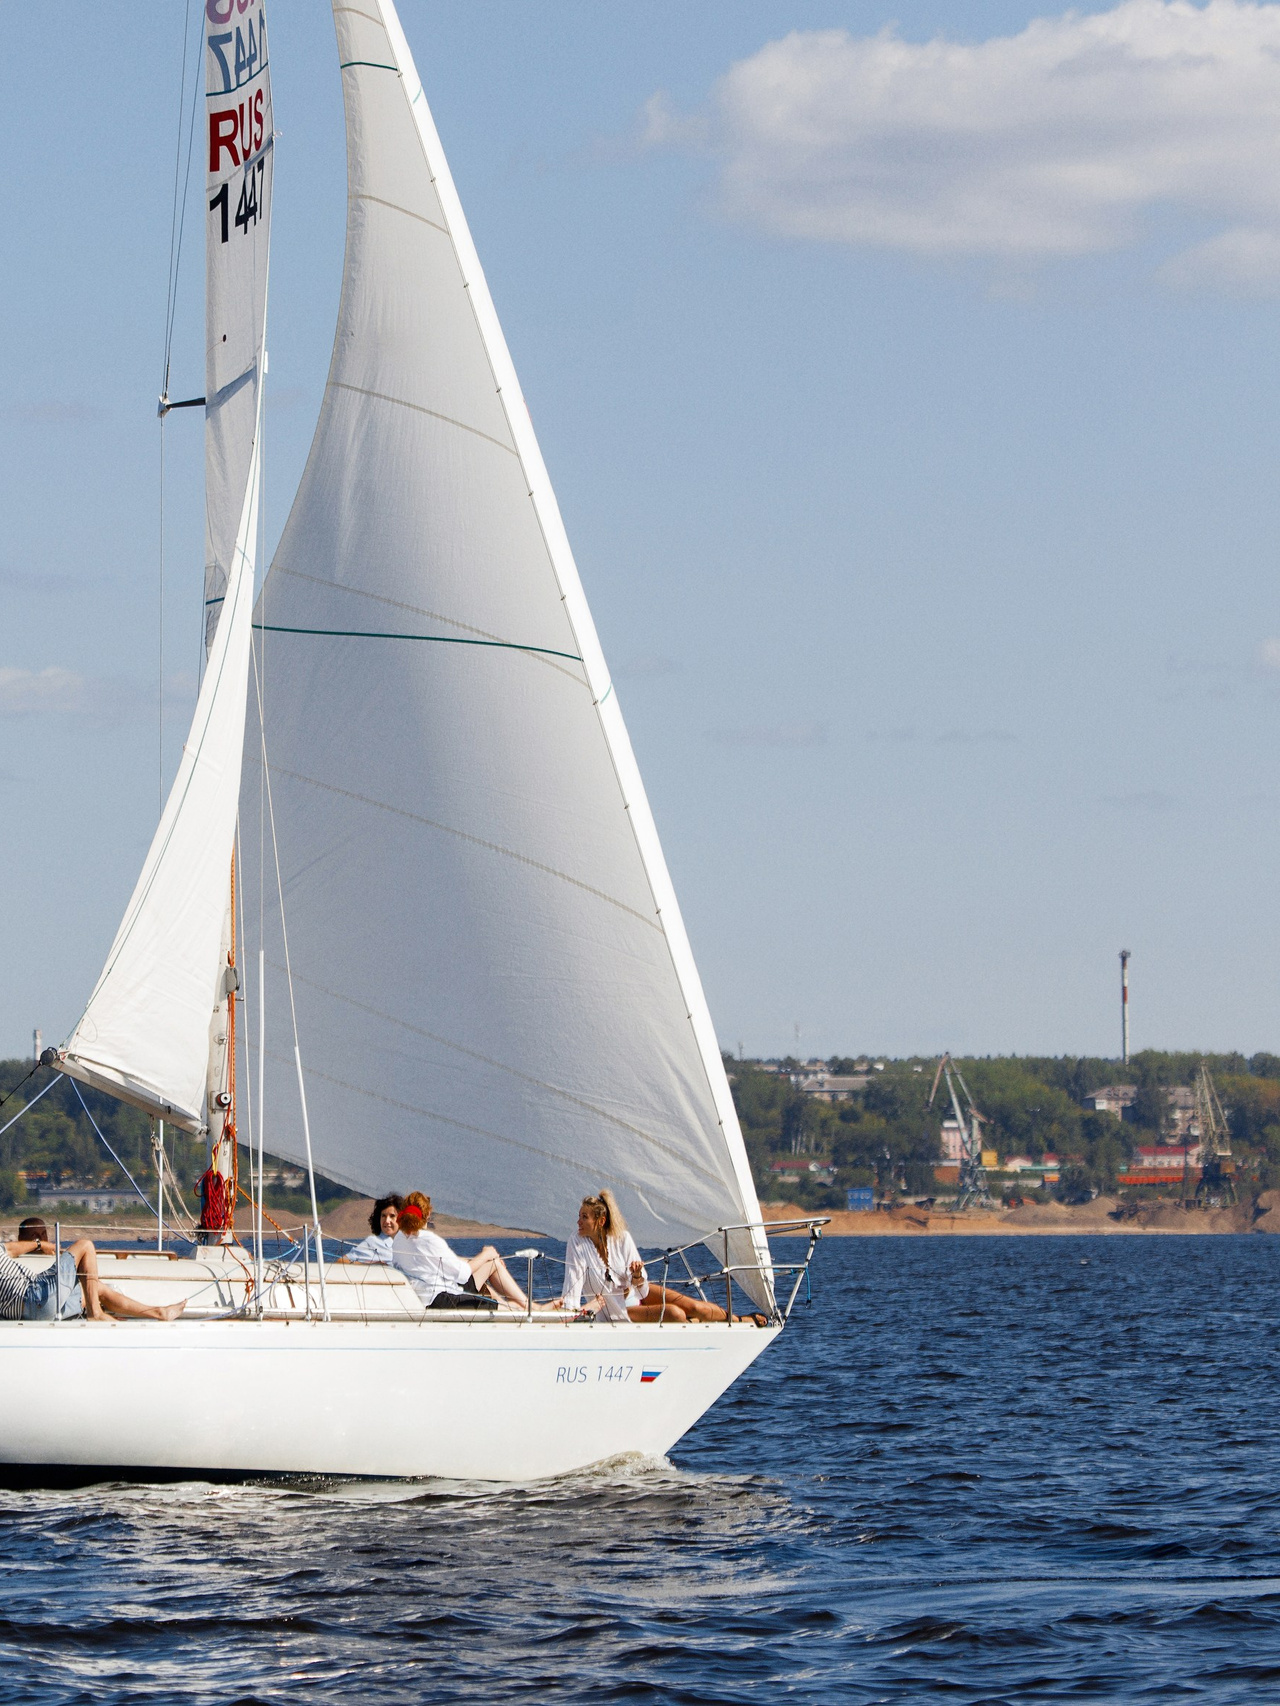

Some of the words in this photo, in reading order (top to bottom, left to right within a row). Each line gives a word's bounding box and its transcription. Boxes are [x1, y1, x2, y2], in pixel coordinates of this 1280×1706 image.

[209, 88, 263, 172] RUS
[209, 156, 265, 244] 1447
[556, 1366, 587, 1383] RUS
[597, 1365, 633, 1382] 1447
